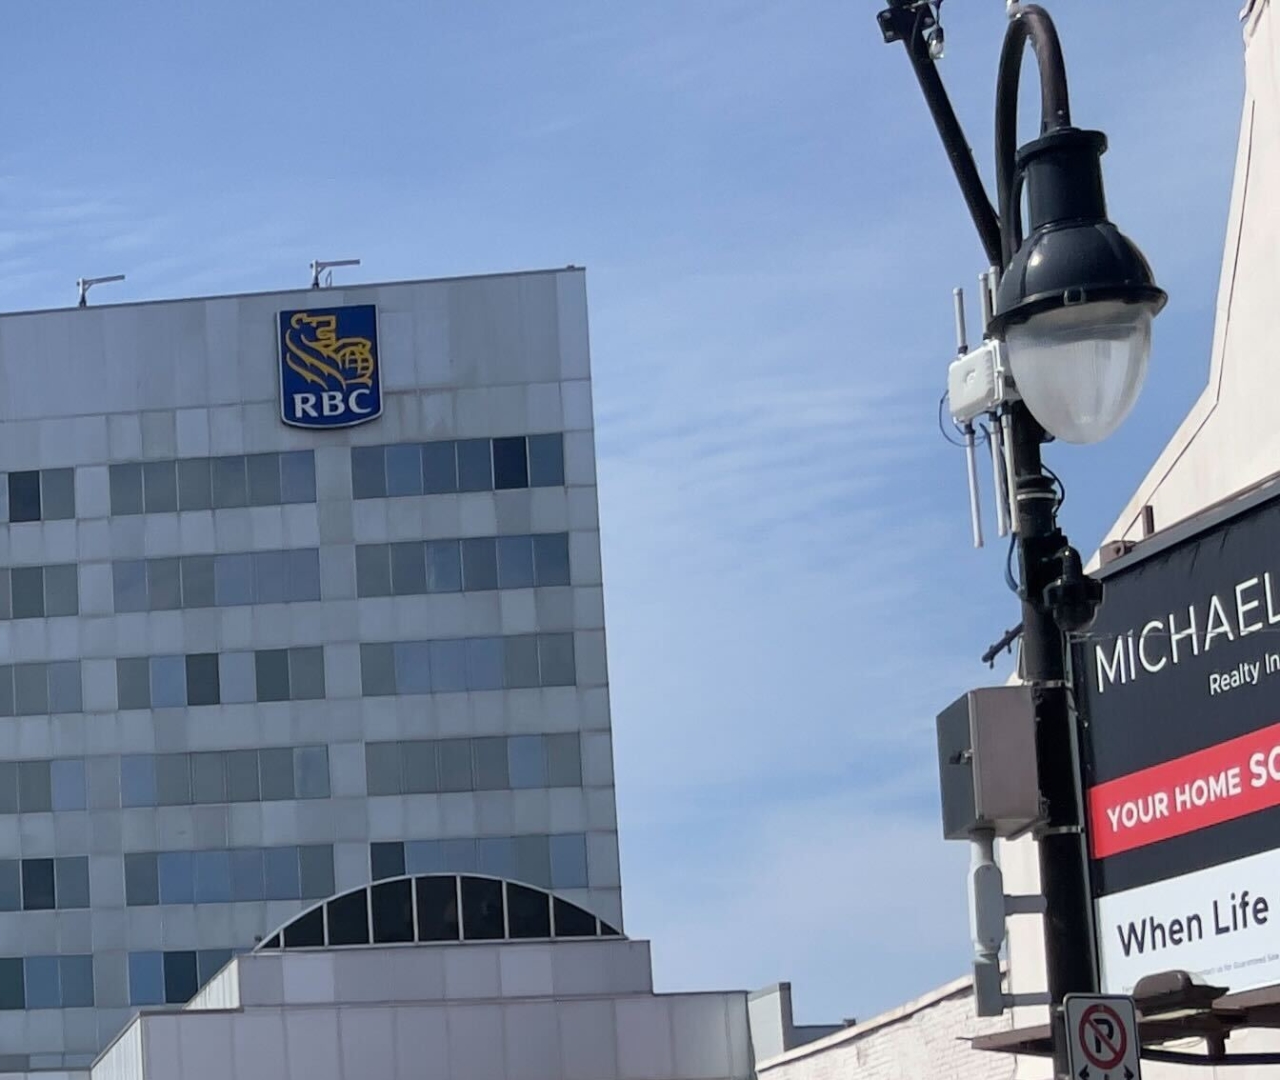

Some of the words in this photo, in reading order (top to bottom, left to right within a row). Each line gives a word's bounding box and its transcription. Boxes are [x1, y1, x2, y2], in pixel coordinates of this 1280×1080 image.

[292, 389, 372, 418] RBC
[1095, 572, 1280, 693] MICHAEL
[1209, 661, 1260, 695] Realty
[1106, 792, 1169, 833] YOUR
[1174, 766, 1242, 812] HOME
[1116, 912, 1203, 957] When
[1213, 890, 1269, 936] Life
